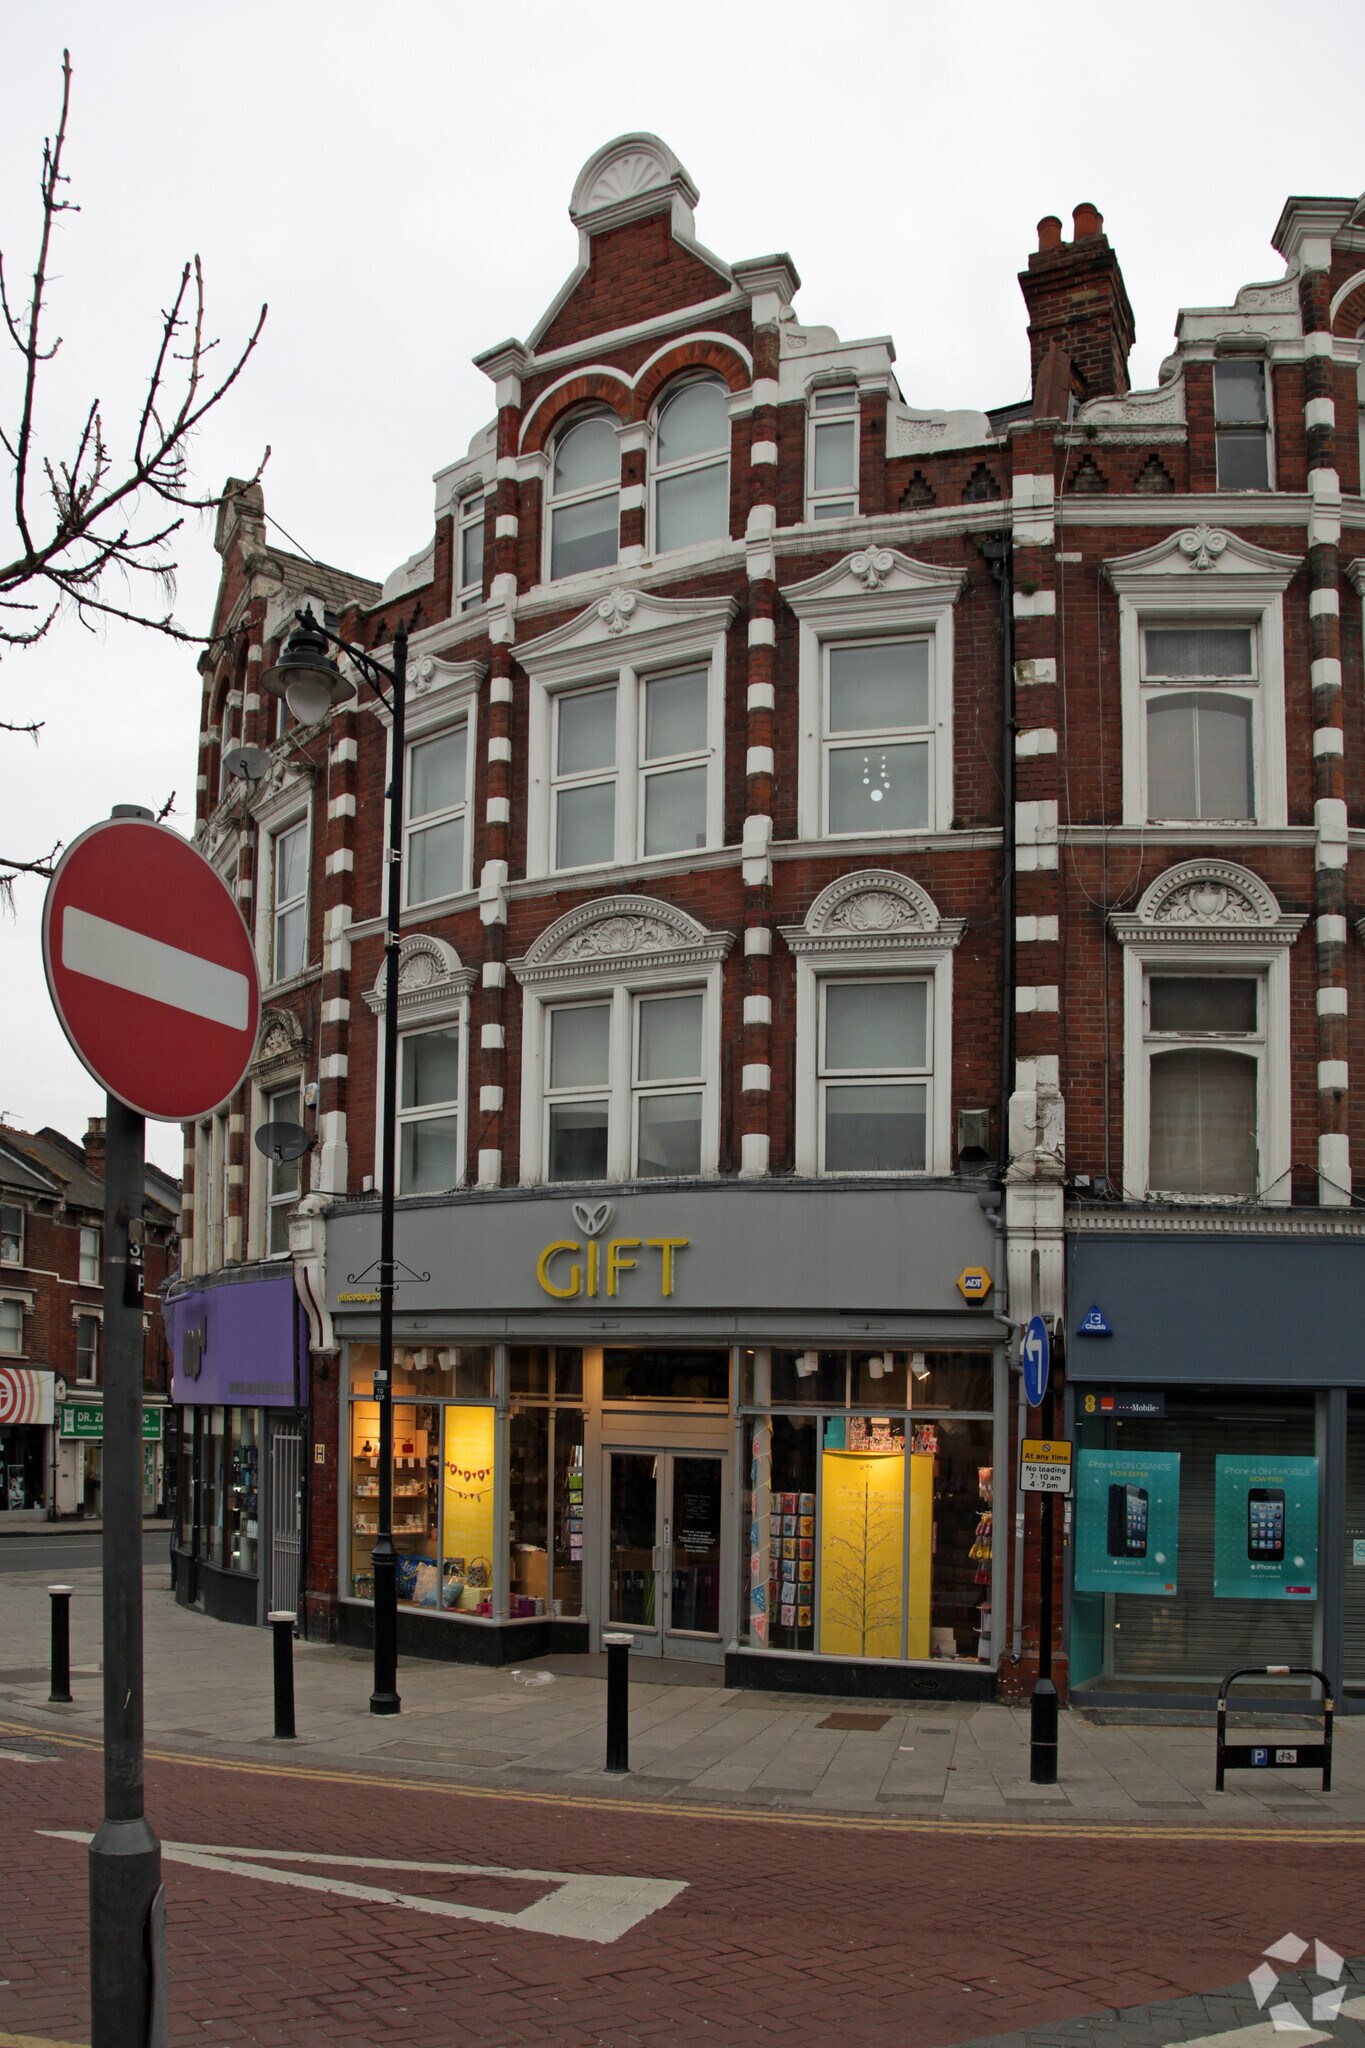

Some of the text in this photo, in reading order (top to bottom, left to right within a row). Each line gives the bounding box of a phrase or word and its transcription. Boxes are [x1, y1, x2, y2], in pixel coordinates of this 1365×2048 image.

[537, 1238, 690, 1298] GIFT
[965, 1278, 982, 1288] ADT
[337, 1293, 382, 1303] officedog.co
[77, 1411, 93, 1422] DR.
[1038, 1466, 1067, 1475] loading
[1088, 1461, 1114, 1470] iPhone
[1115, 1462, 1121, 1470] 5
[1136, 1463, 1172, 1472] ORANGE
[1224, 1466, 1311, 1477] iPhone 4 ON T-MOBILE
[1249, 1475, 1285, 1484] NOW FREE
[1256, 1563, 1277, 1571] iPhone
[1254, 1751, 1265, 1764] P
